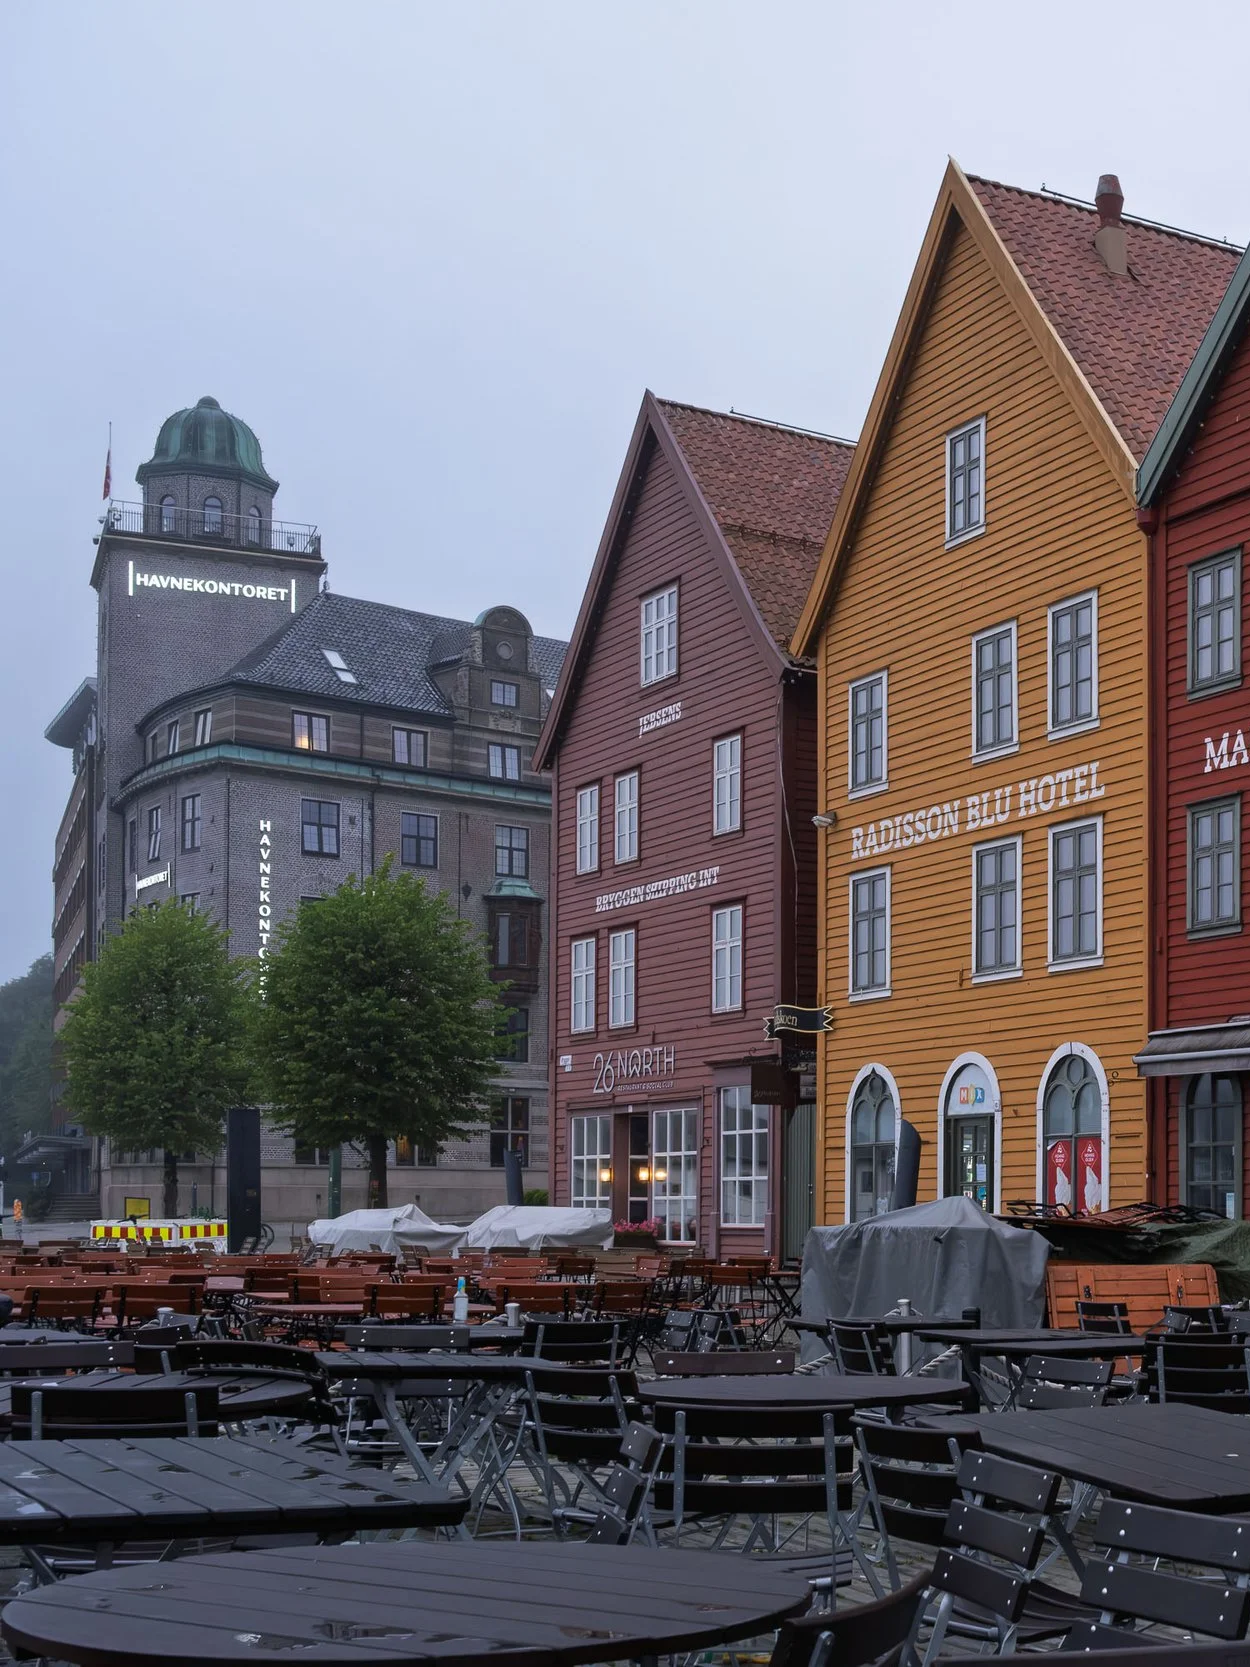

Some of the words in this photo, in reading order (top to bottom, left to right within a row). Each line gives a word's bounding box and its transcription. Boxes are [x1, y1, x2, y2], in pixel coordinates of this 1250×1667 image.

[136, 573, 289, 601] HAVNEKONTORET
[639, 702, 682, 739] JEBSENS
[851, 800, 961, 860] RADISSON
[966, 786, 1013, 831] BLU
[1018, 761, 1106, 818] HOTEL
[258, 820, 271, 1000] HAVNEKONTO
[595, 885, 645, 913] BRYGGEN
[646, 872, 697, 900] SHIPPING
[699, 866, 720, 888] INT
[593, 1051, 615, 1094] 26
[617, 1045, 675, 1079] NORTH
